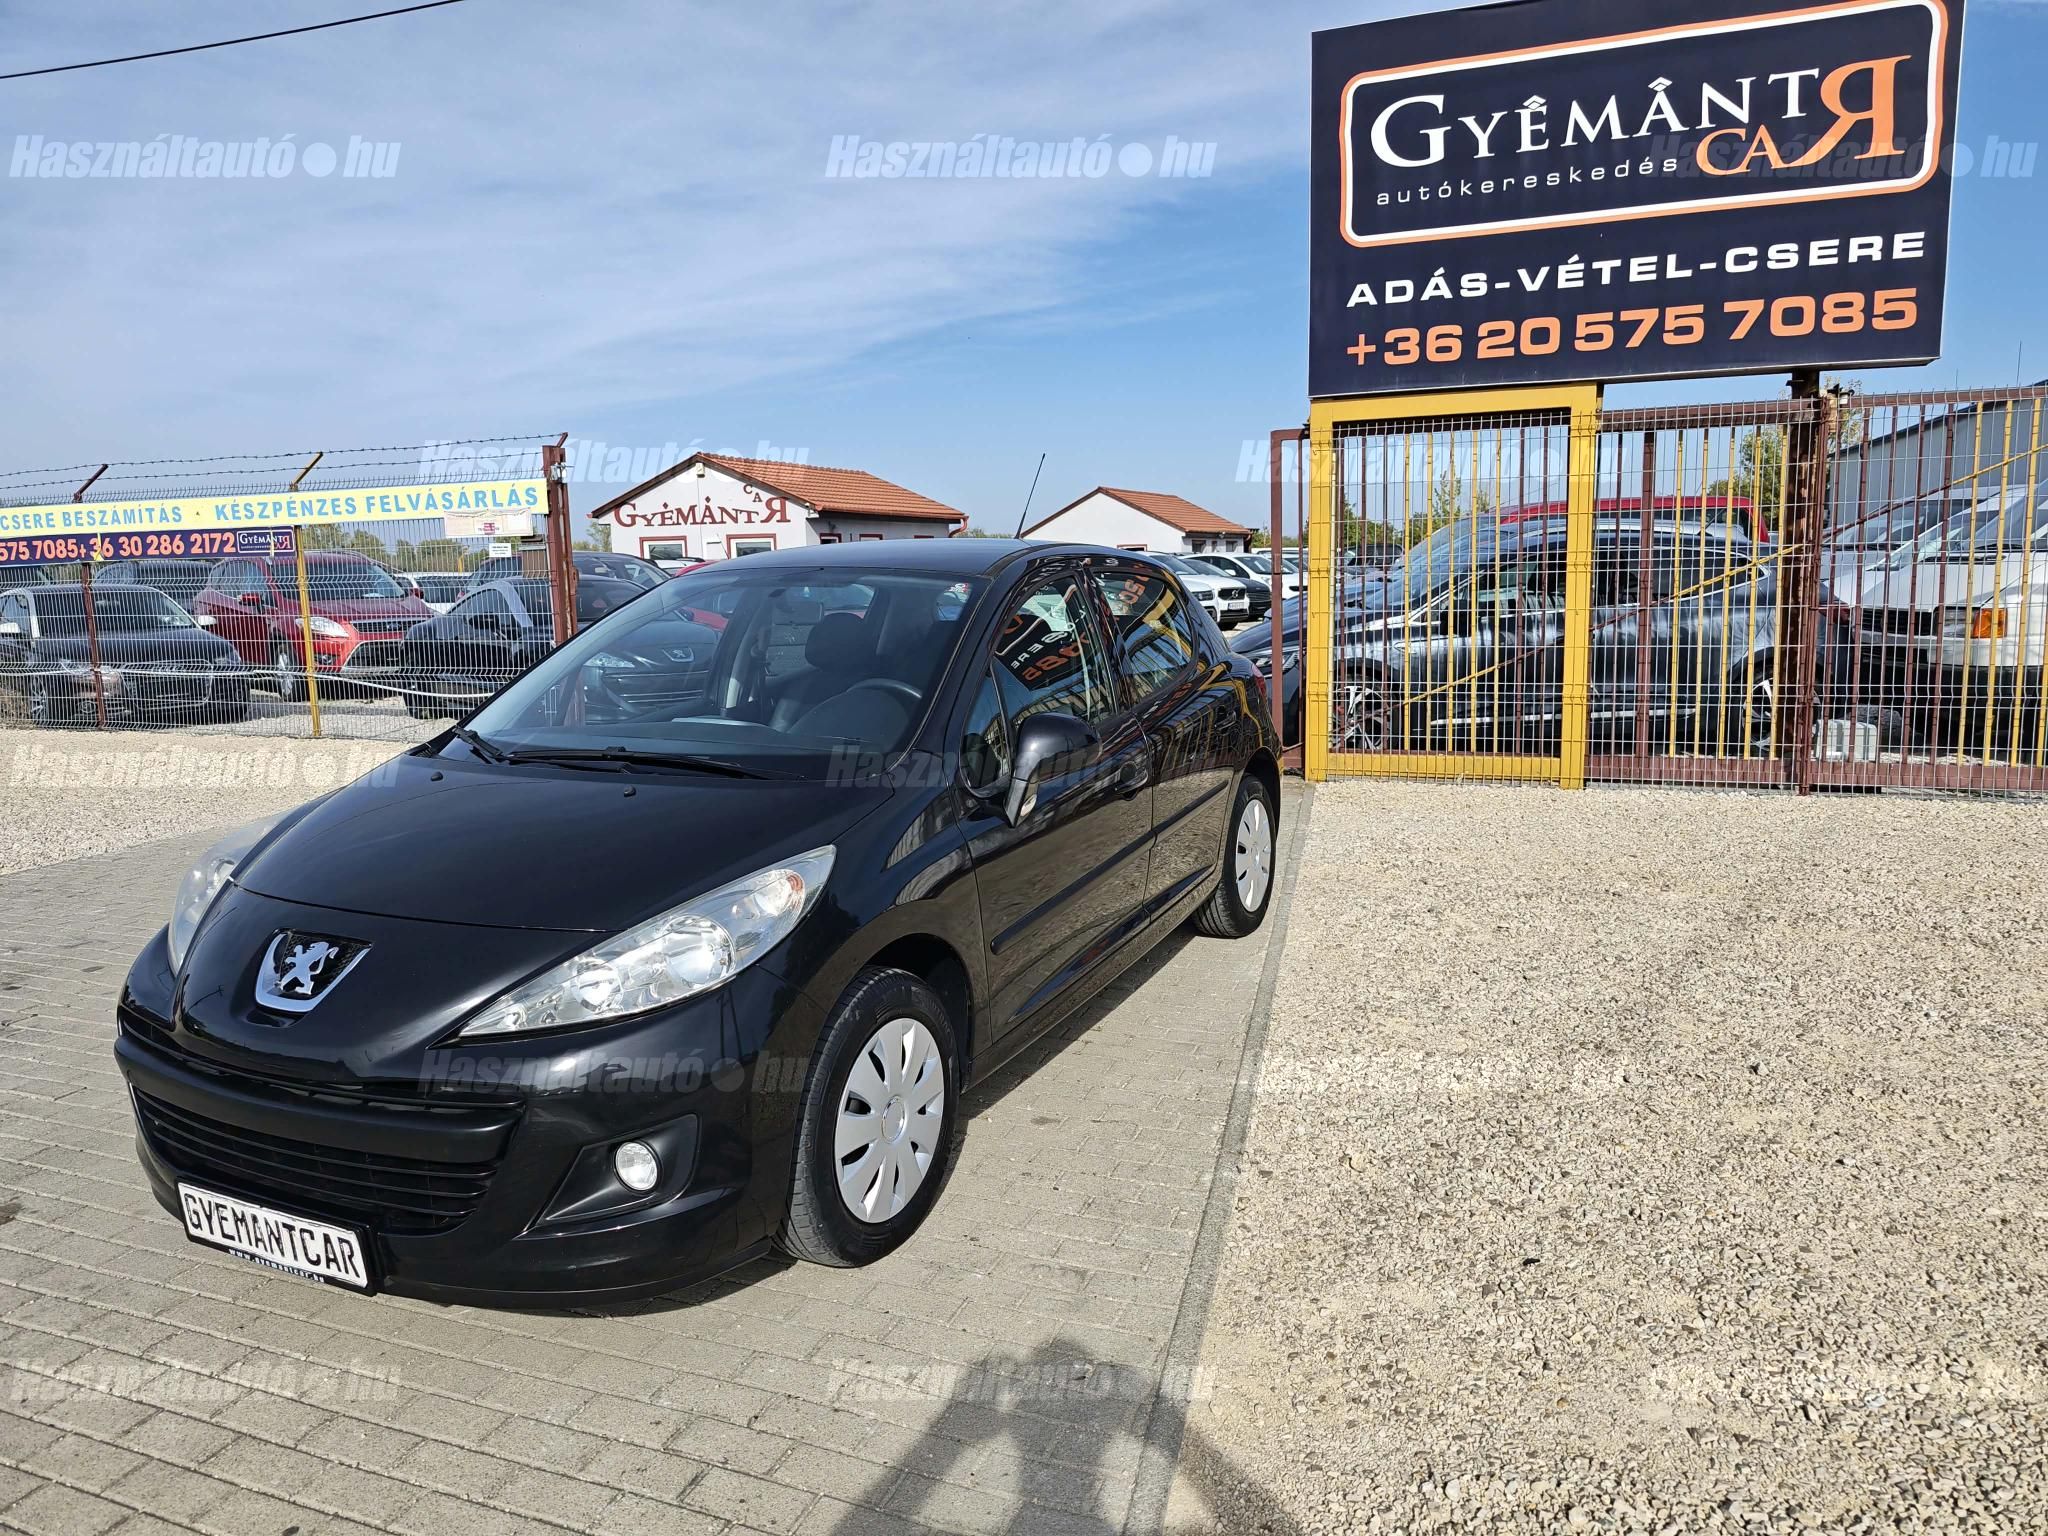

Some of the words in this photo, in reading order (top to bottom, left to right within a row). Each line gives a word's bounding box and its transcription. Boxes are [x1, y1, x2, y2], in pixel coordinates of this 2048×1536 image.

[1376, 157, 1677, 206] autókereskedés
[1346, 231, 1926, 308] ADÁS-VÉTEL-CSERE
[1347, 324, 1463, 366] +36
[1476, 316, 1561, 359] 20
[1574, 304, 1705, 352] 575
[1723, 287, 1918, 340] 7085
[1, 512, 55, 531] CSERE
[63, 503, 183, 528] BESZÁMÍTÁS
[215, 496, 357, 521] KÉSZPÉNZES
[366, 483, 538, 513] FELVÁSÁRLÁS
[119, 535, 142, 557] 30
[146, 534, 185, 556] 286
[190, 532, 236, 554] 2172
[183, 1193, 361, 1279] GYEMANTCAR
